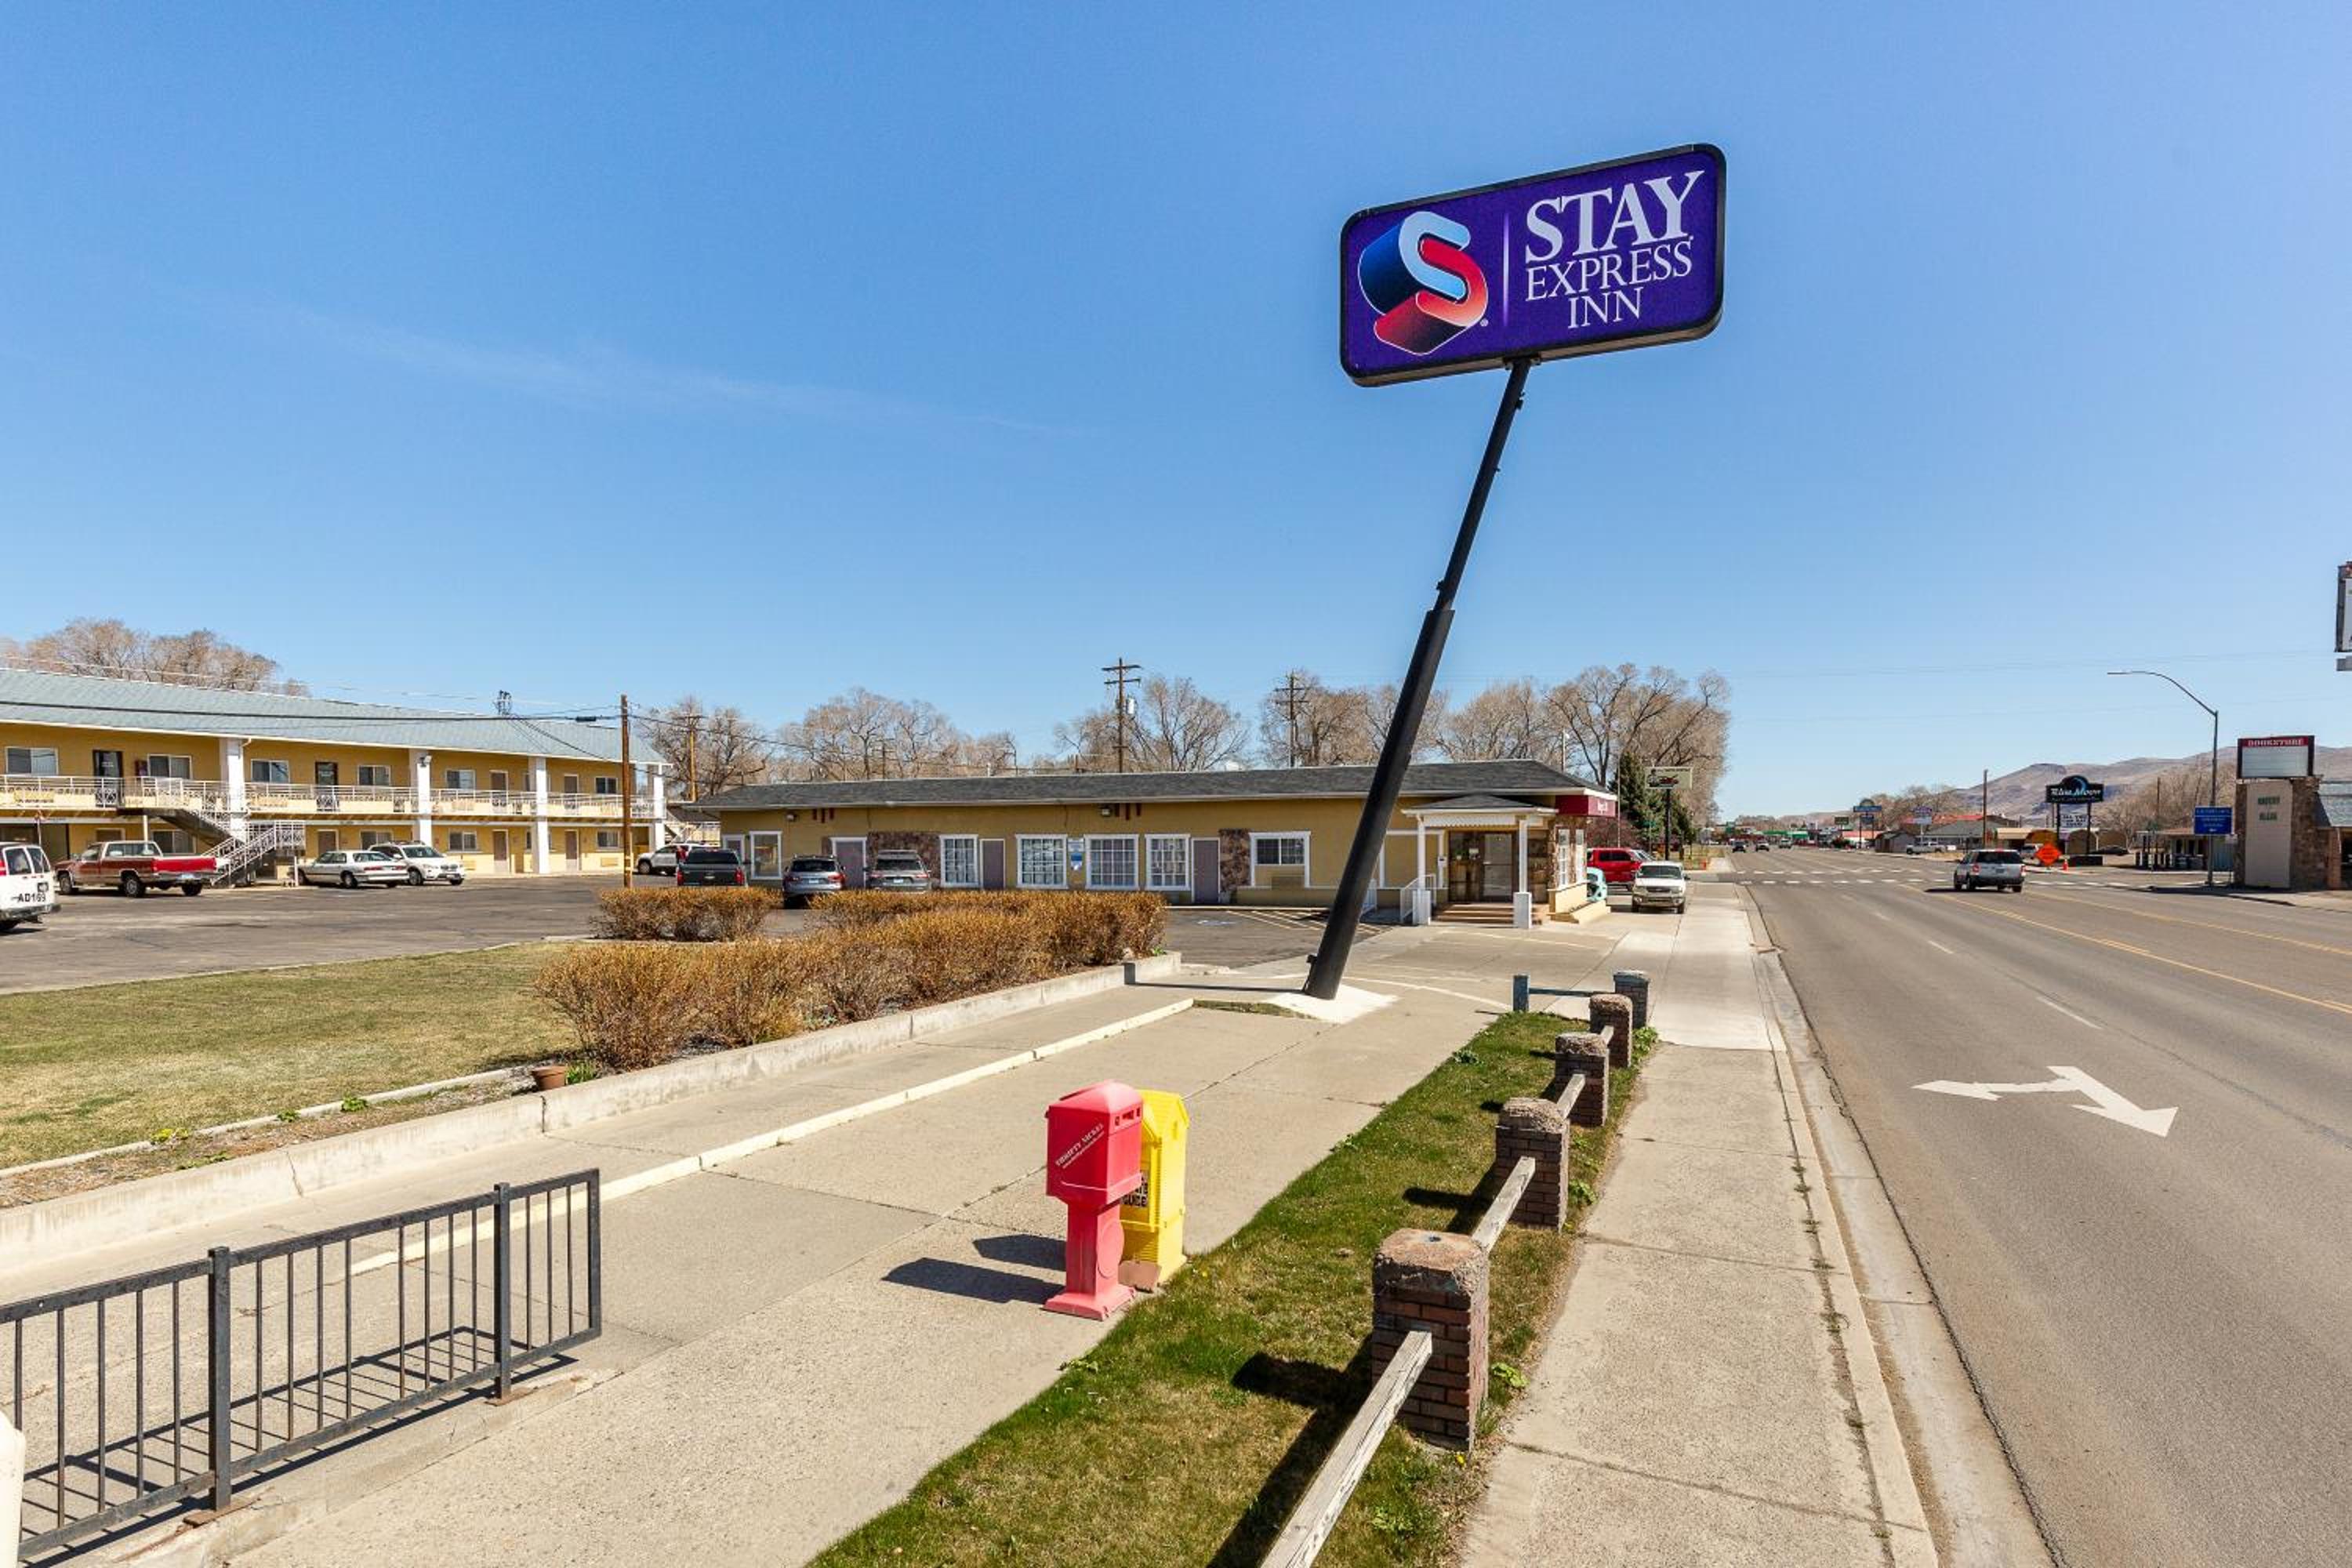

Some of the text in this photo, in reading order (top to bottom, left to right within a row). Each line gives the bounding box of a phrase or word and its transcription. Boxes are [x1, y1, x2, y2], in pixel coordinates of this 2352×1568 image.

[1526, 170, 1705, 263] STAY
[1526, 239, 1693, 302] EXPRESS
[1568, 286, 1644, 328] INN
